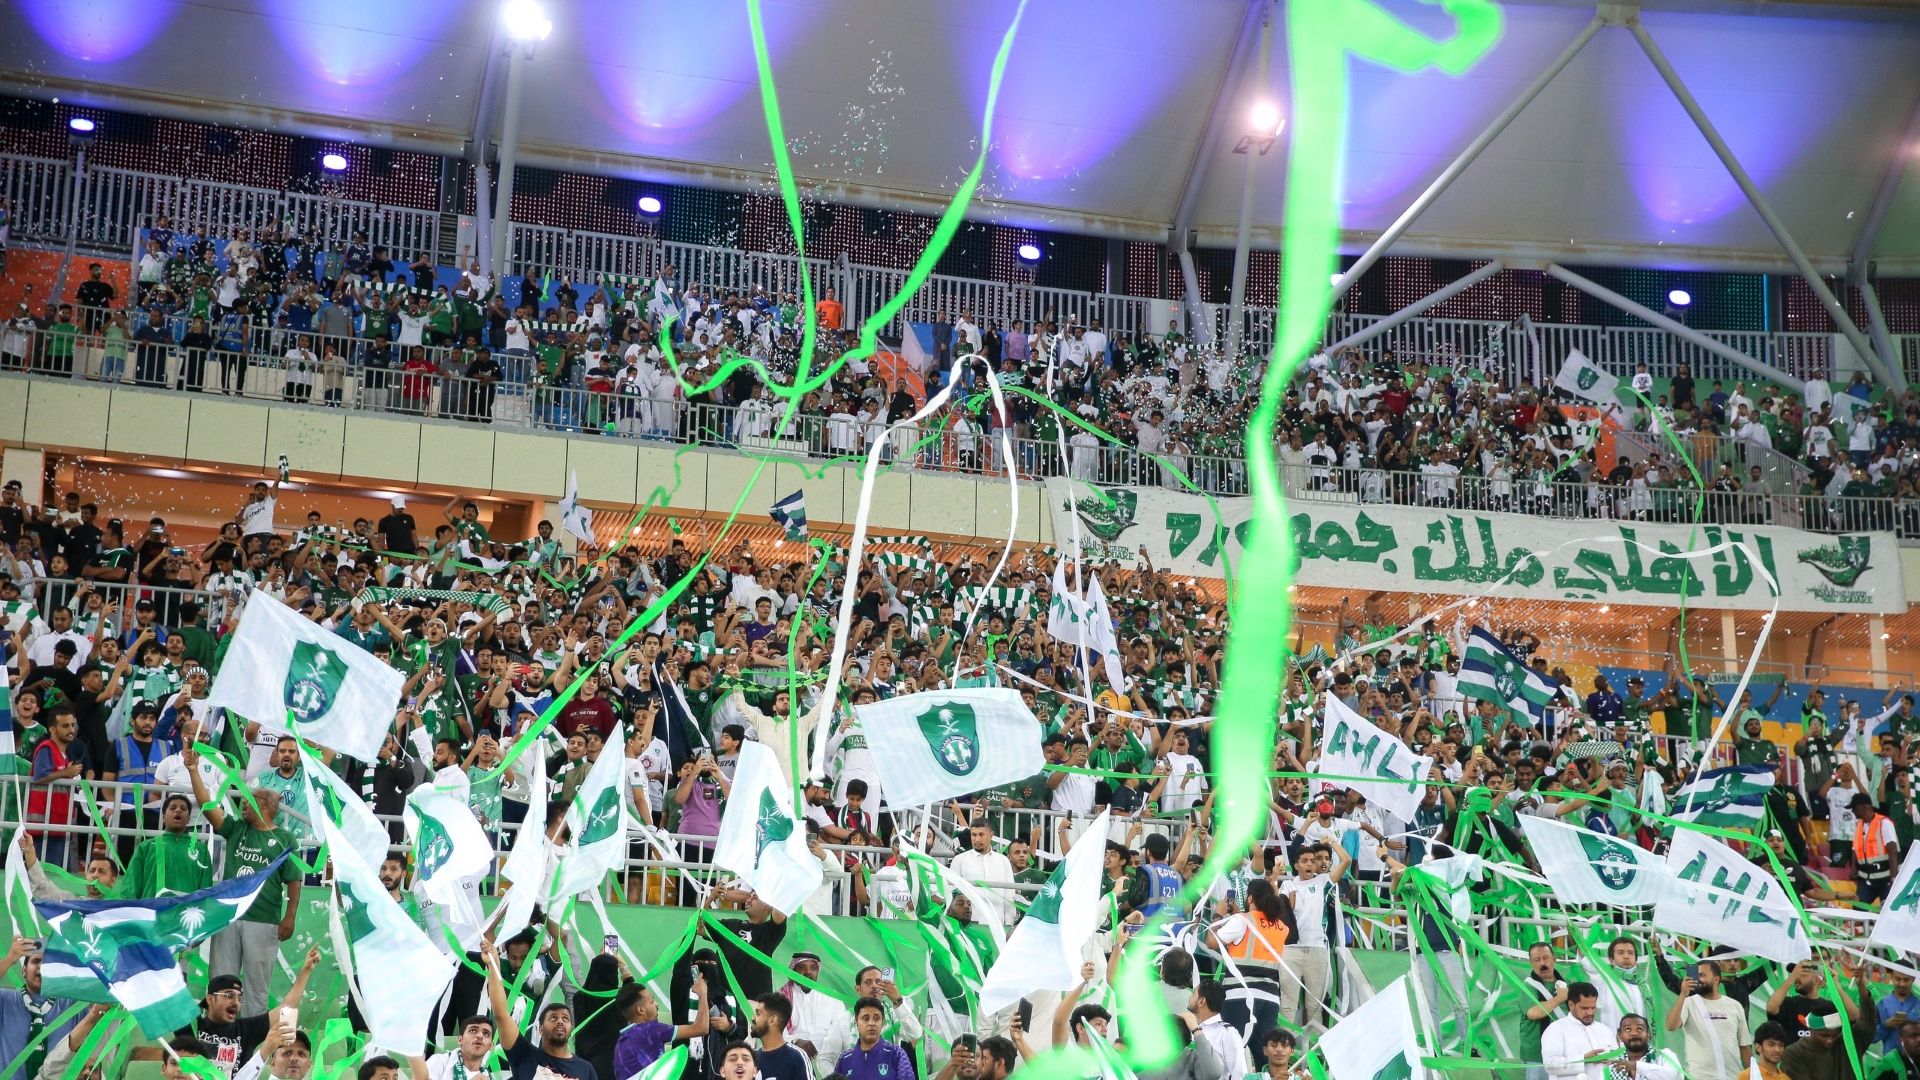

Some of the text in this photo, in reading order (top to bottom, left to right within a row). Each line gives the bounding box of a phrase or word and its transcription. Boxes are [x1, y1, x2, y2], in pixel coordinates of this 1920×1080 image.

[1412, 514, 1544, 587] ملك
[1327, 720, 1422, 794] AHLI
[234, 849, 271, 867] SAUDIA
